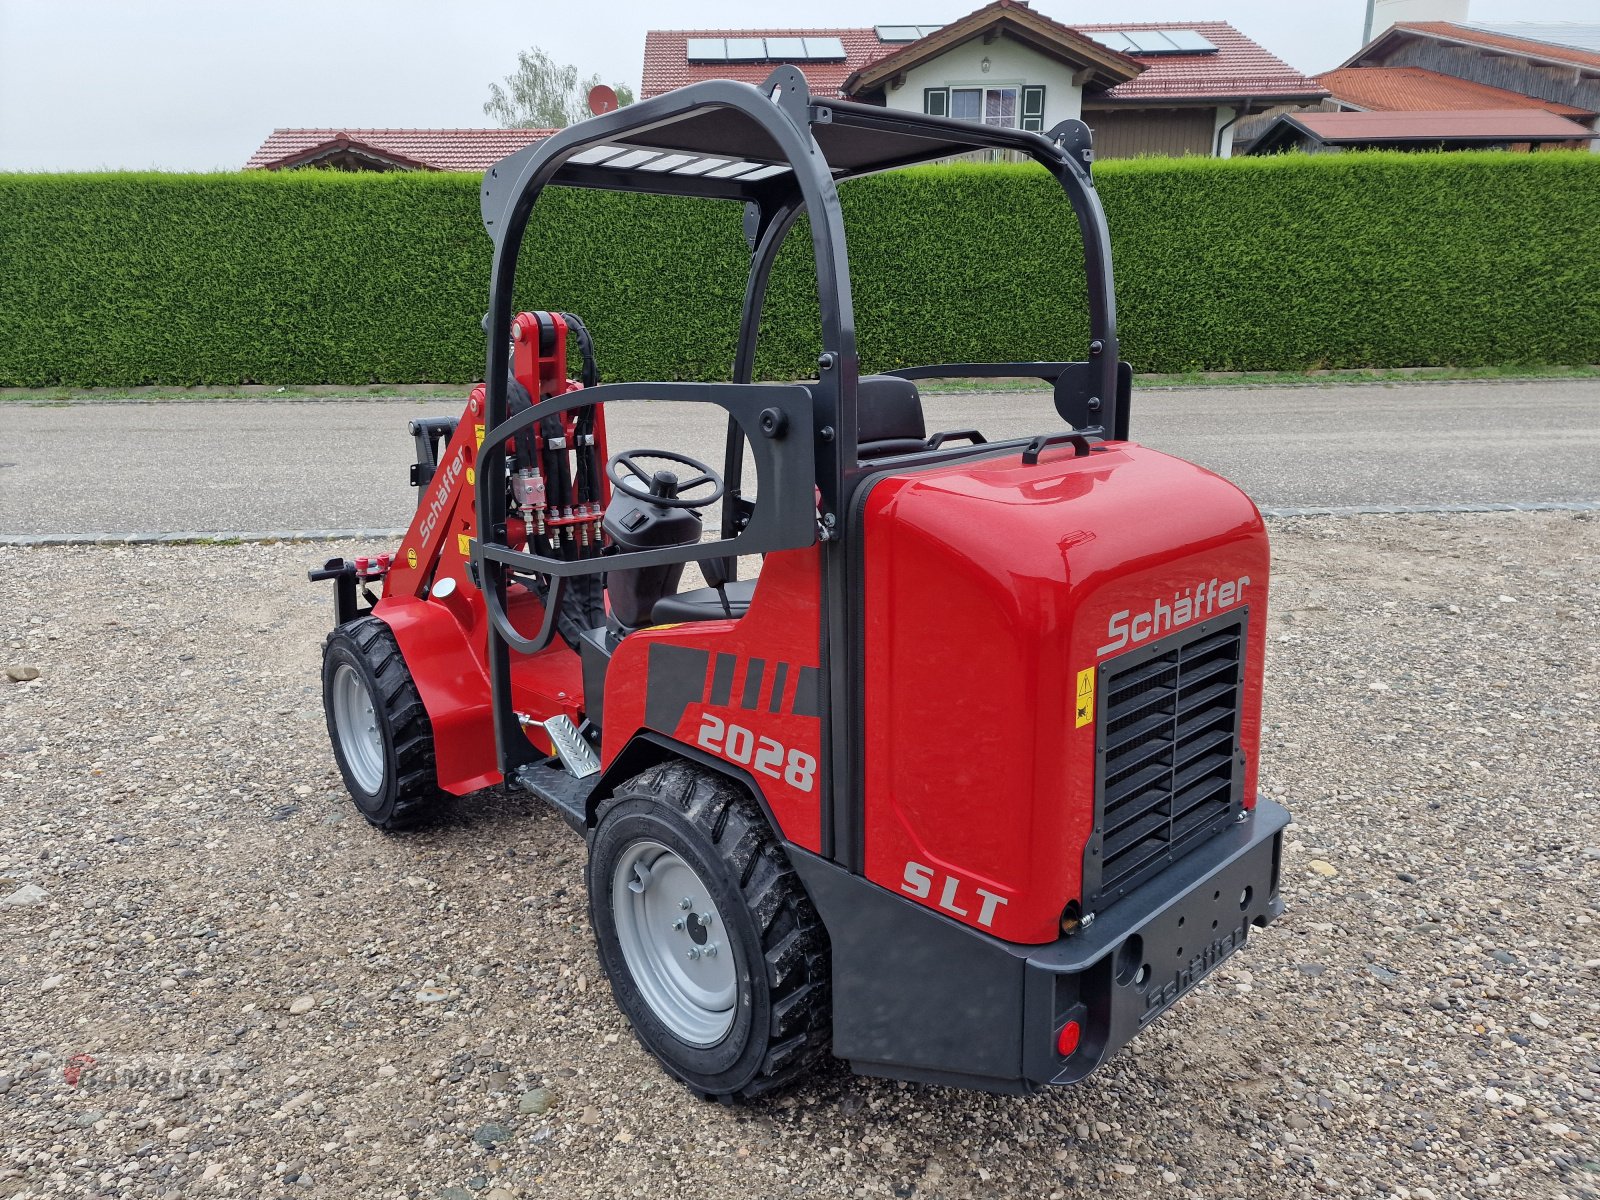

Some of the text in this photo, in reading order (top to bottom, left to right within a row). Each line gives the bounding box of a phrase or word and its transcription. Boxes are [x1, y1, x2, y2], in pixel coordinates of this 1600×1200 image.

[420, 446, 465, 549] Schäffer
[1096, 575, 1251, 657] Schäffer
[697, 711, 817, 793] 2028
